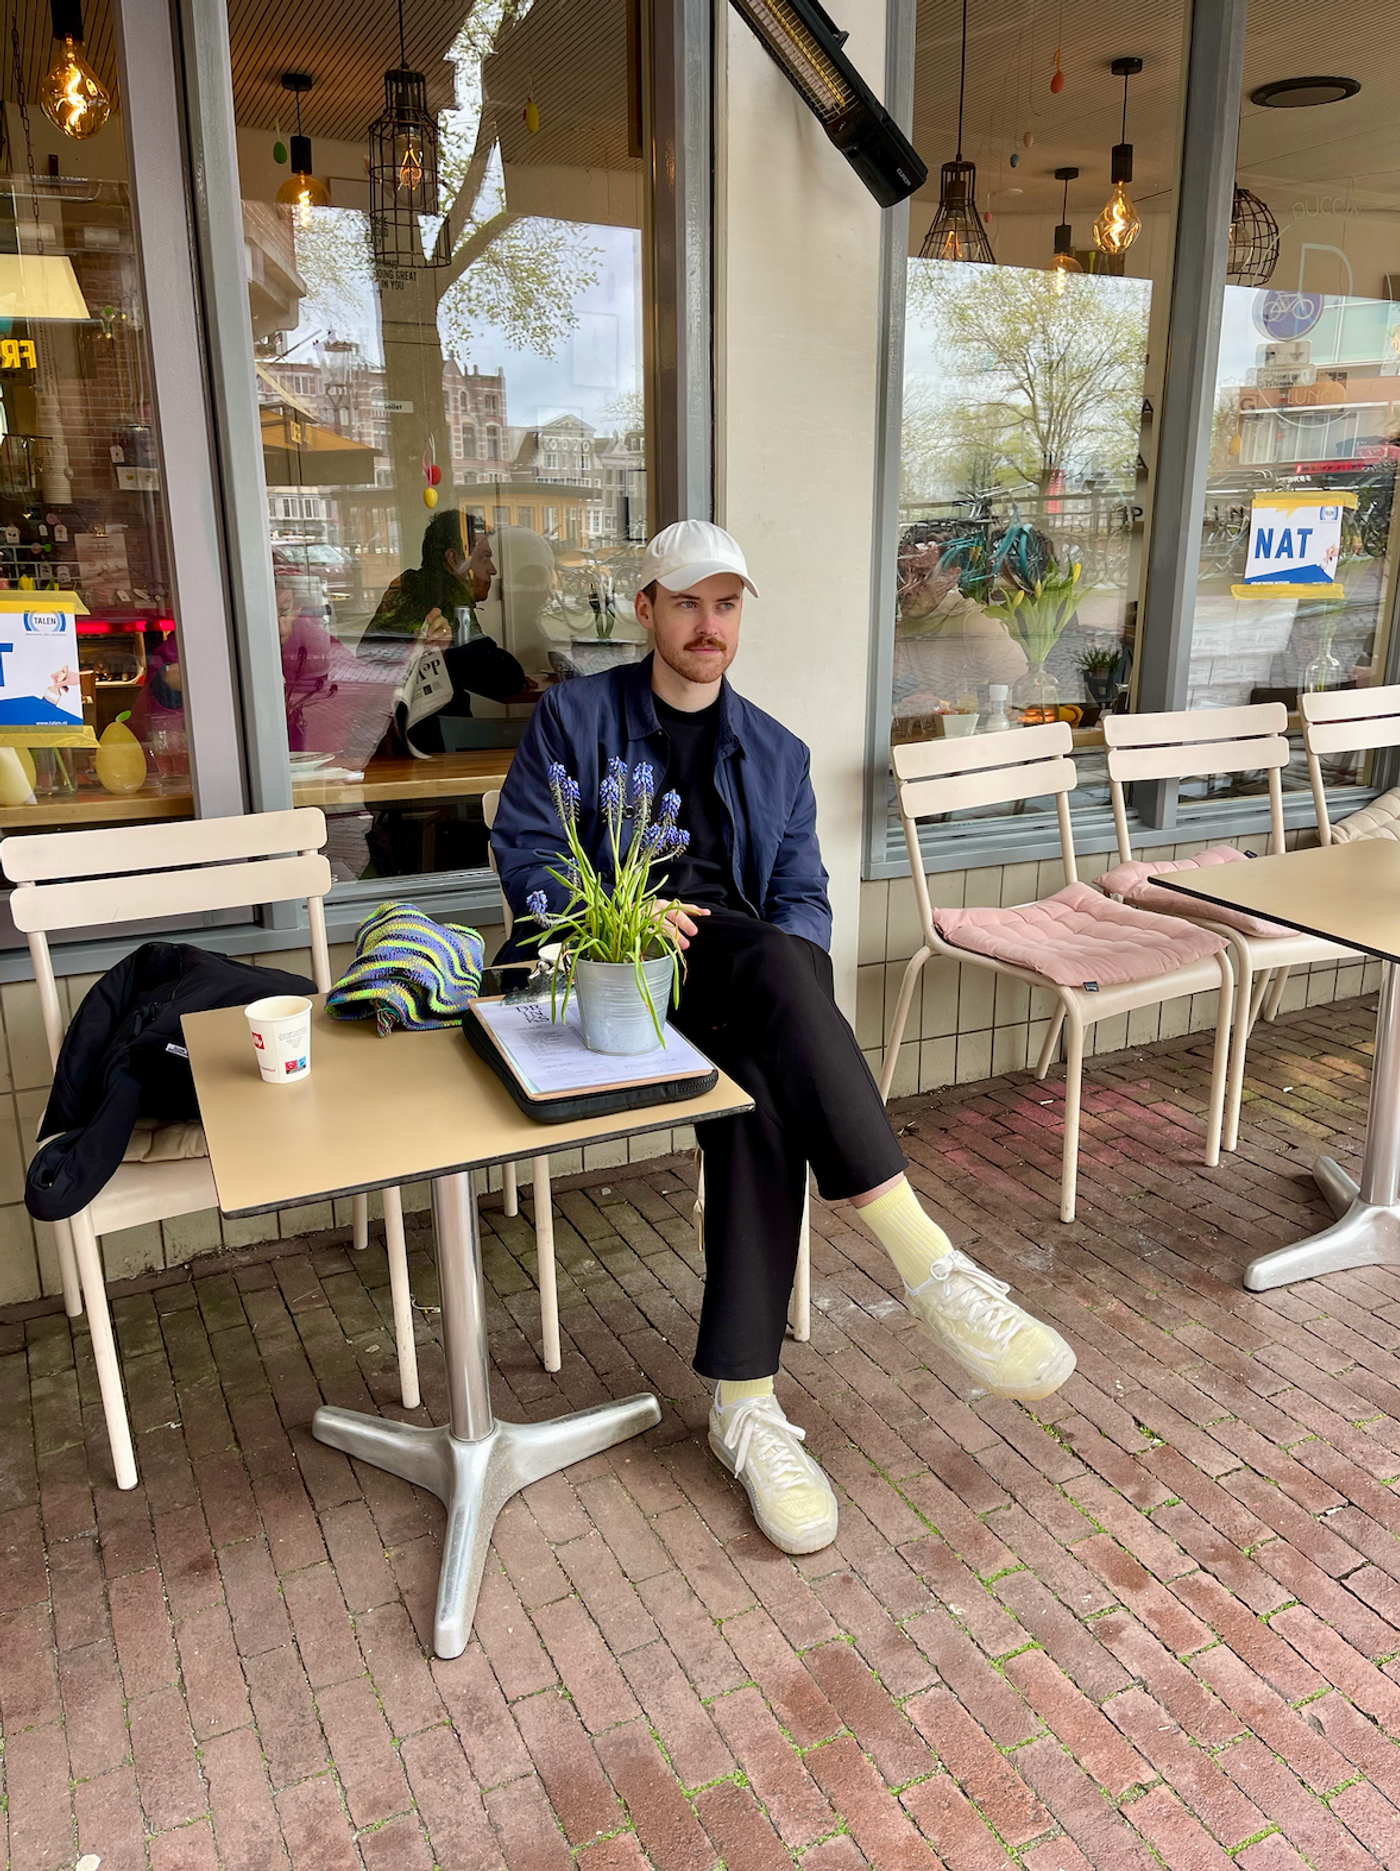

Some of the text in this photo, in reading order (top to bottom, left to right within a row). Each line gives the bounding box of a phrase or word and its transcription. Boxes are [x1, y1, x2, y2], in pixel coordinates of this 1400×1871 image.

[395, 270, 417, 281] GREAT
[390, 280, 404, 290] YOU
[1254, 527, 1314, 559] NAT
[33, 617, 56, 626] TALEN
